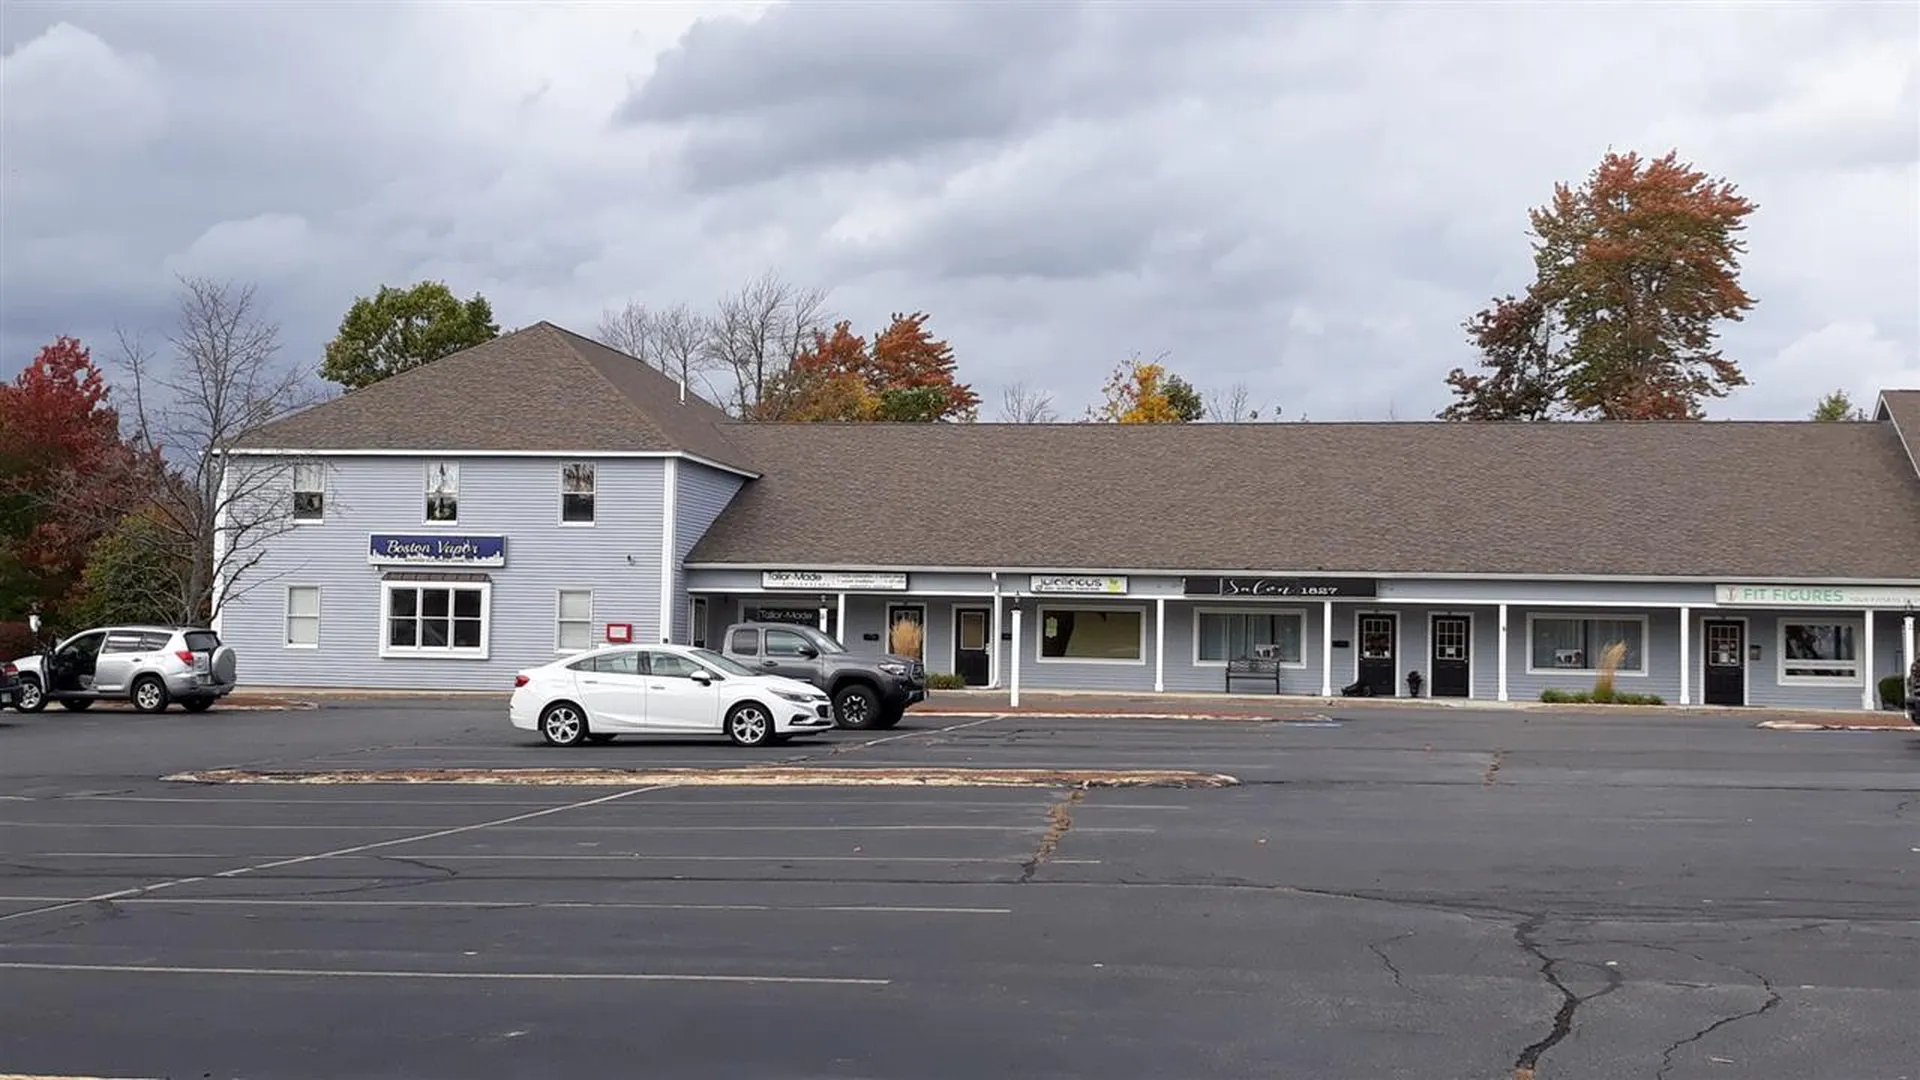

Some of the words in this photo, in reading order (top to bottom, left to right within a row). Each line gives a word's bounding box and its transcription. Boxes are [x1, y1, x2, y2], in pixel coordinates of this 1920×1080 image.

[386, 539, 431, 554] Boston
[437, 539, 478, 557] Vapor
[1301, 587, 1338, 595] 1827
[1743, 588, 1767, 602] FIT
[1773, 588, 1844, 602] FIGURES
